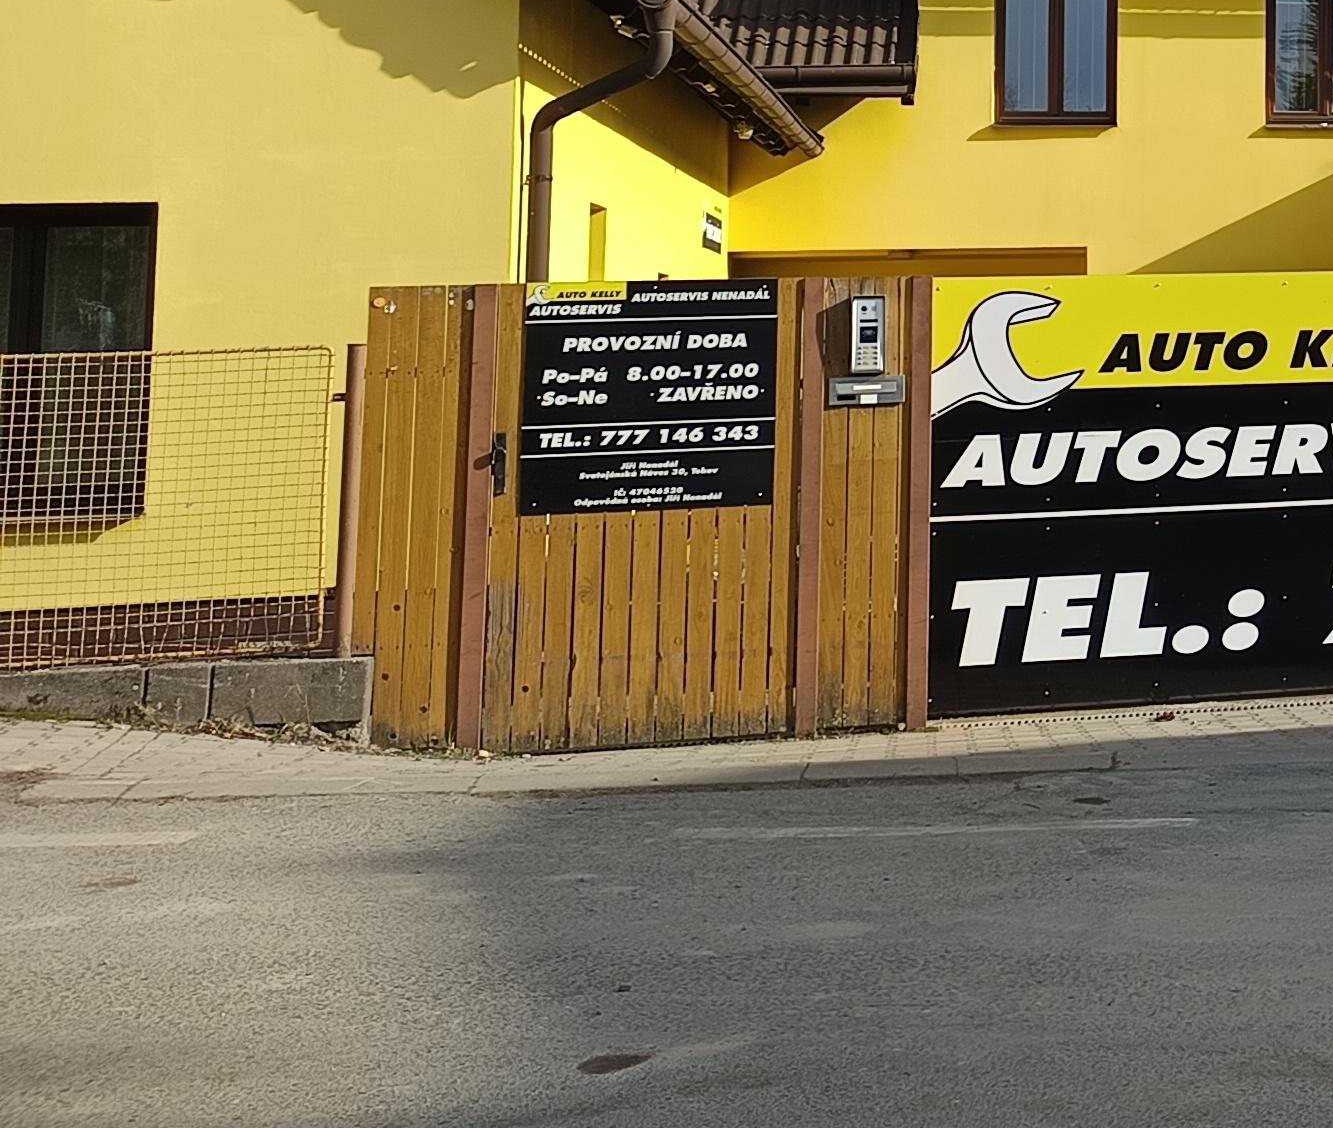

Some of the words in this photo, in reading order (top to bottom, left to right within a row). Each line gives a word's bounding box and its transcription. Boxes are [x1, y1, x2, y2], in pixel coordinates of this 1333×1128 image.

[631, 292, 709, 302] AUTOSERVIS
[712, 288, 770, 300] NENADÁL
[529, 304, 622, 317] AUTOSERVIS
[562, 331, 682, 352] PROVOZNÍ
[686, 333, 748, 350] DOBA
[1098, 329, 1269, 374] AUTO
[542, 367, 608, 384] Po-Pá
[626, 363, 760, 382] 8.00-17.00
[541, 390, 608, 406] So-Ne
[657, 382, 759, 402] ZAVŘENO
[539, 432, 592, 448] TEL.:
[600, 429, 650, 446] 777
[659, 427, 704, 444] 146
[712, 425, 759, 442] 343
[950, 571, 1267, 668] TEL.:
